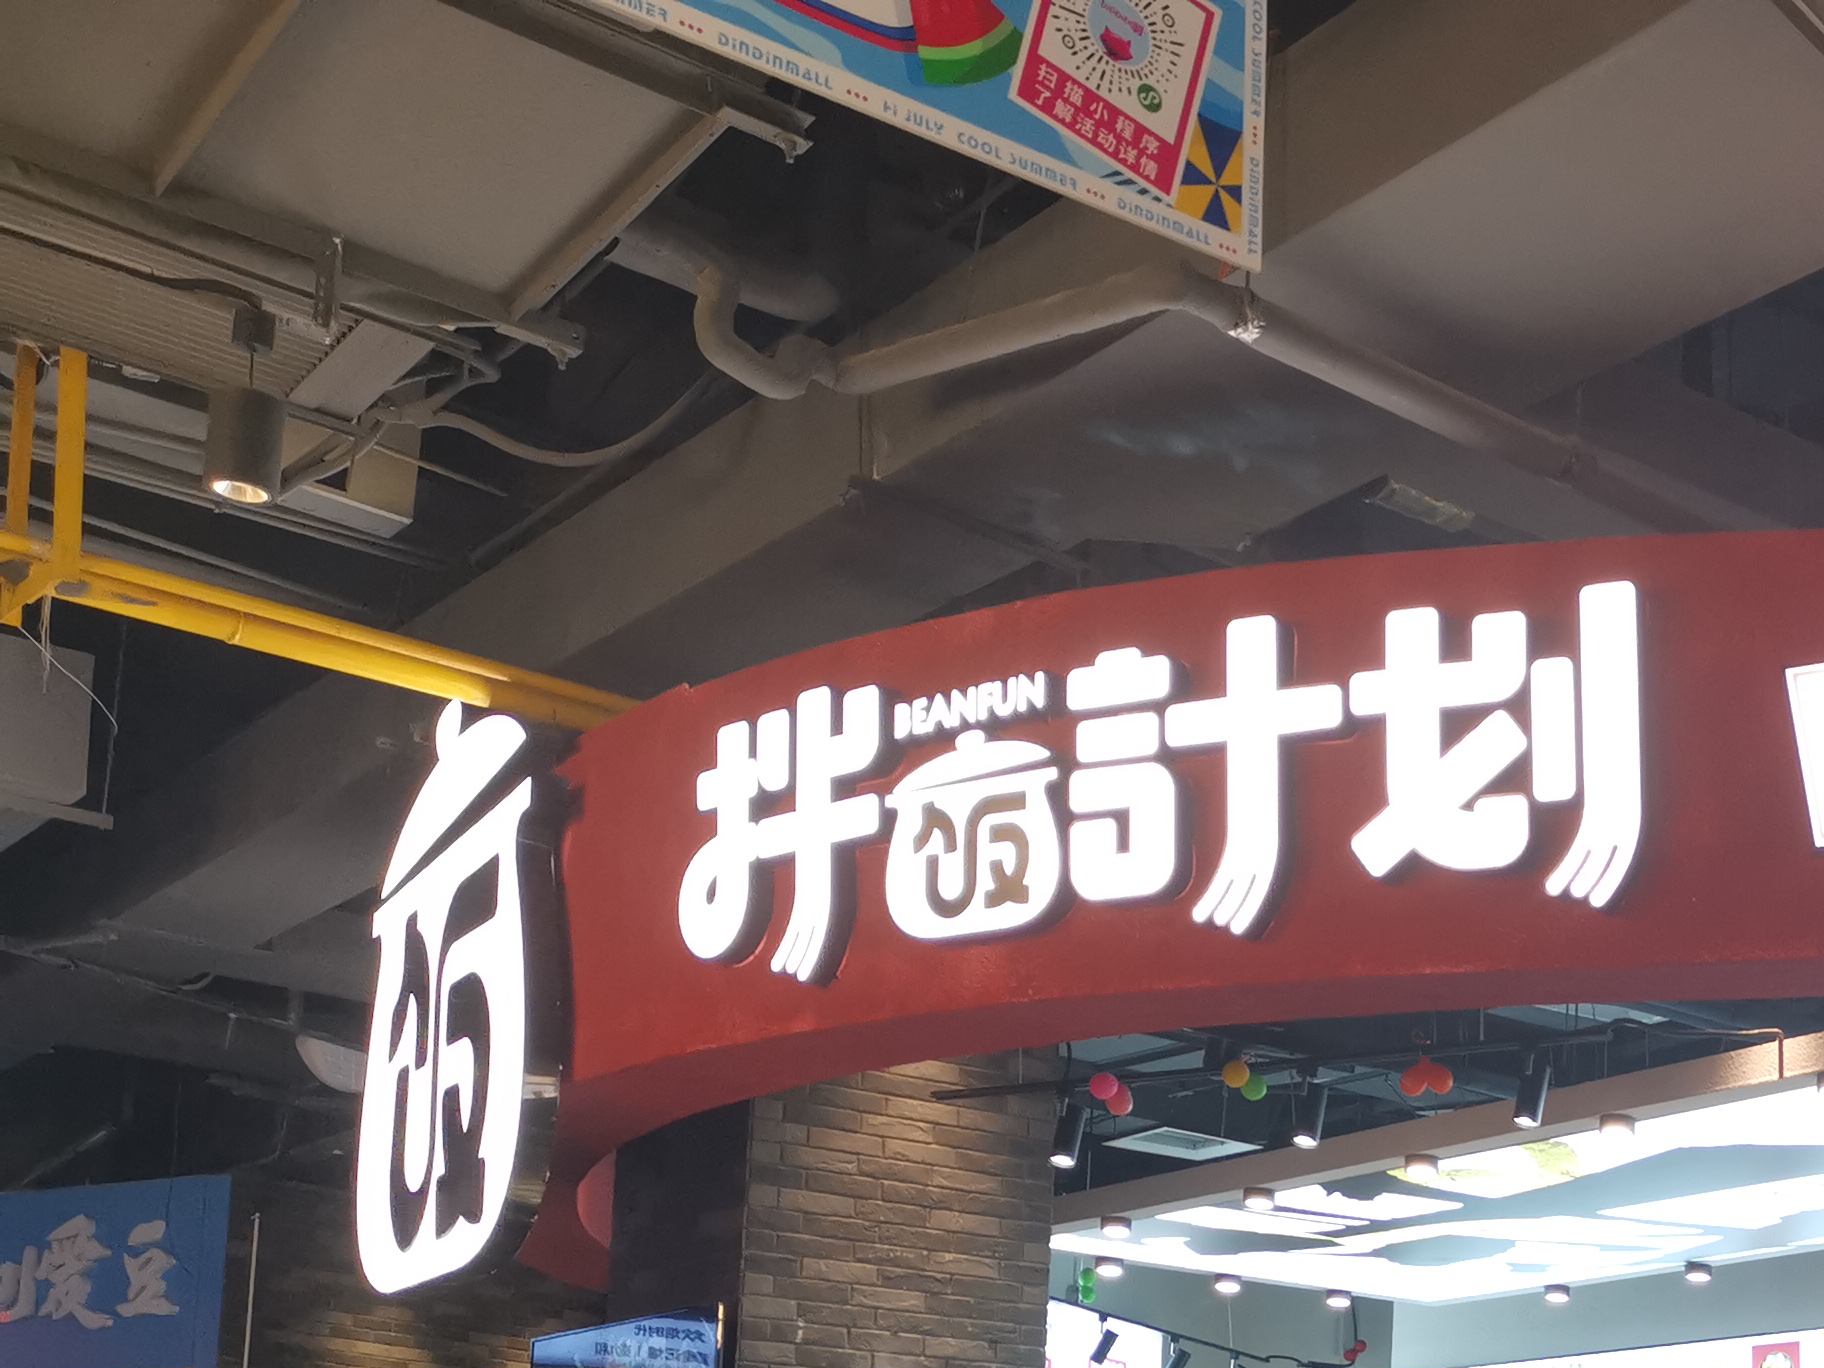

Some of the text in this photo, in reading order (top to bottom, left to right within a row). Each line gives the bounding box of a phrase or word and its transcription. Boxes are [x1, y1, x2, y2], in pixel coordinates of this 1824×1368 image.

[956, 131, 1002, 160] COOL
[1034, 84, 1160, 181] 了解活动详情
[1036, 62, 1162, 155] 扫描小程序
[893, 669, 1047, 740] BEANFUN
